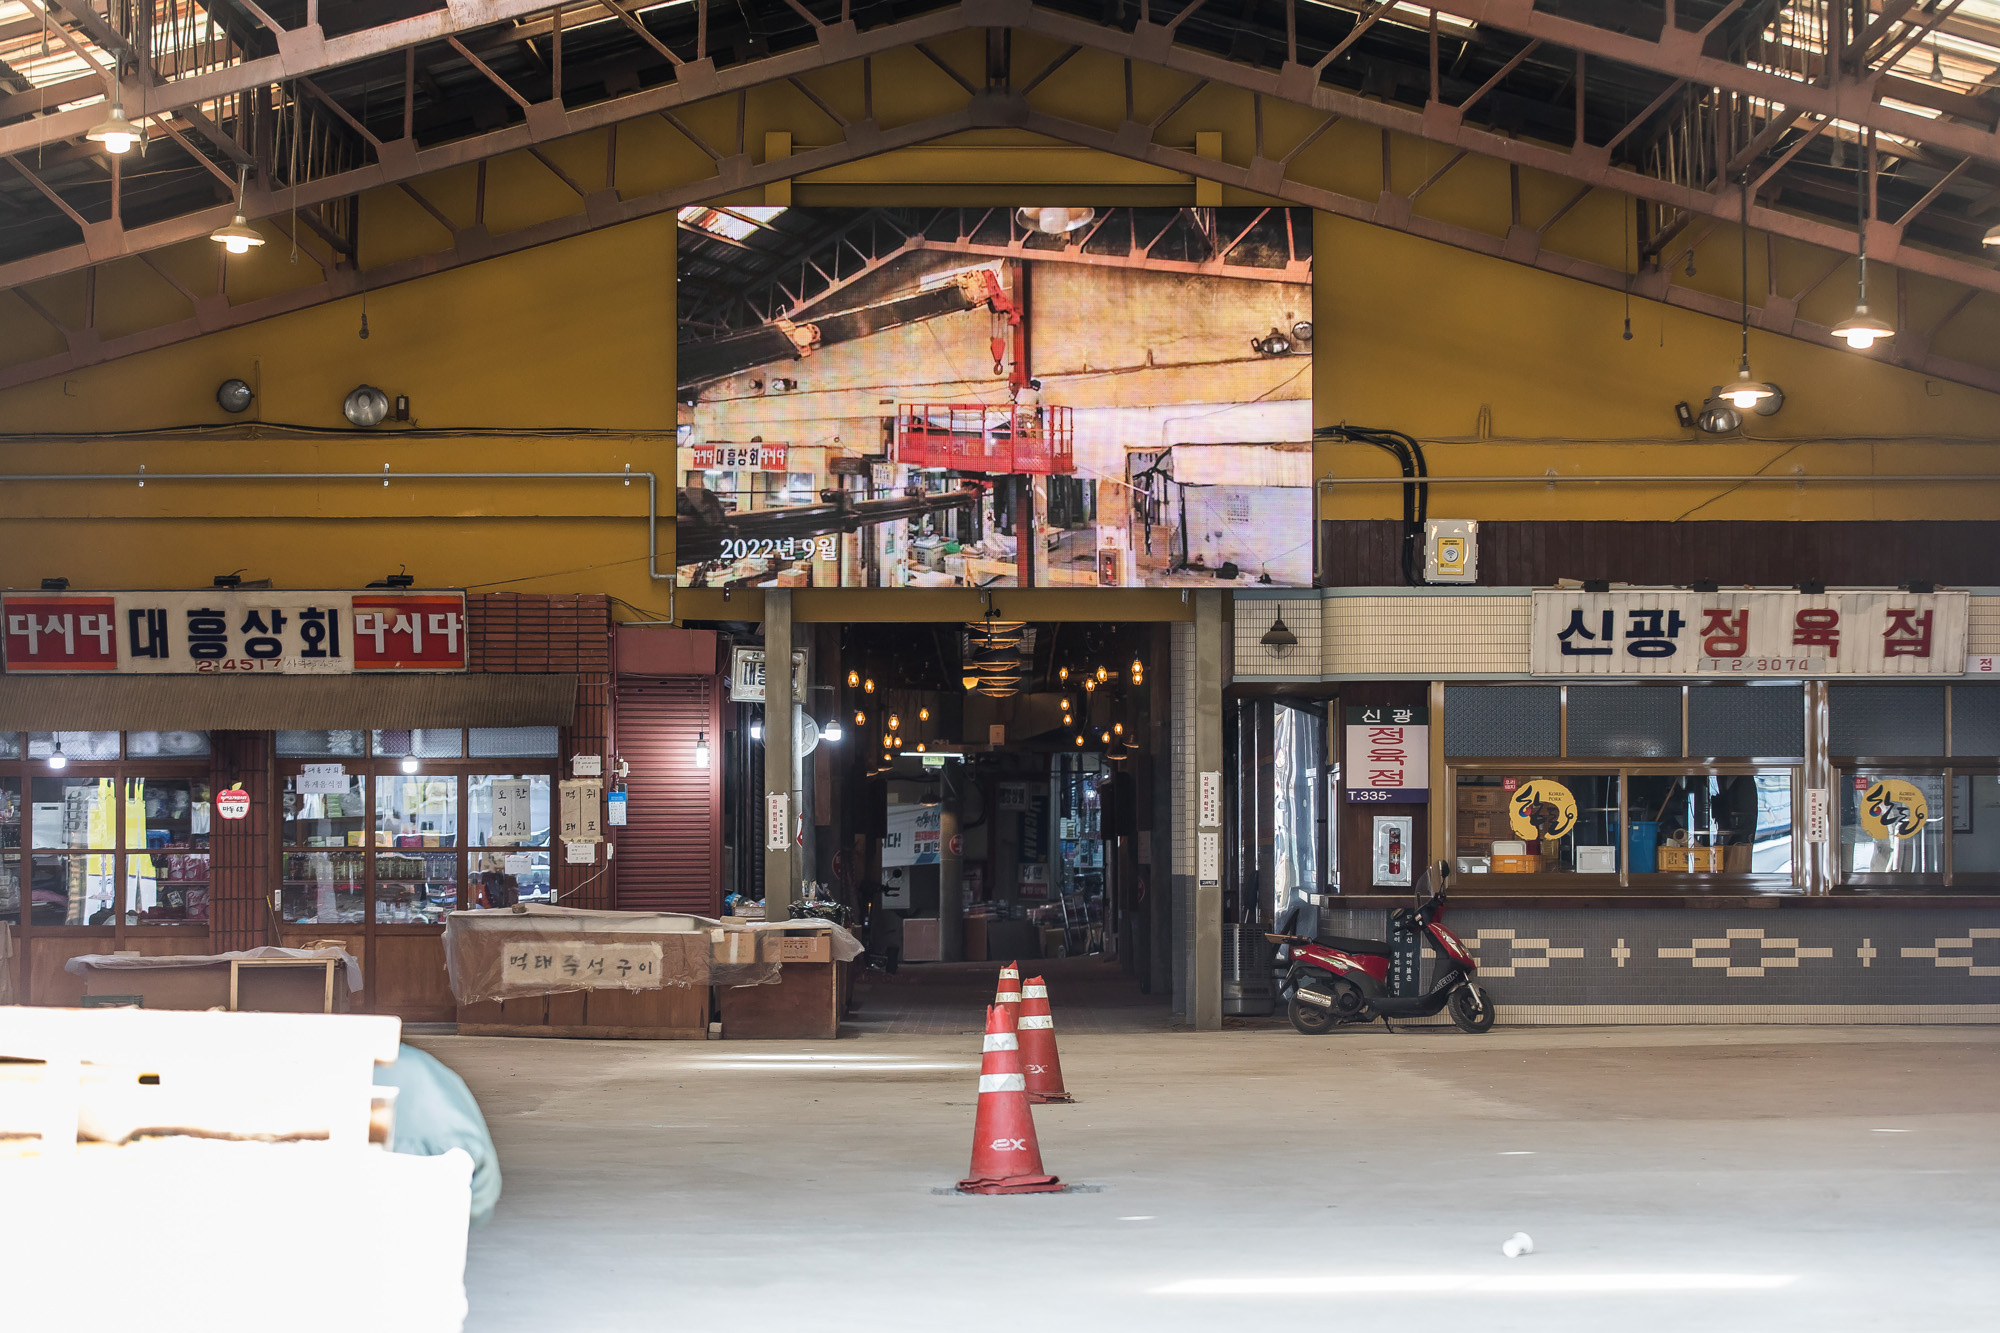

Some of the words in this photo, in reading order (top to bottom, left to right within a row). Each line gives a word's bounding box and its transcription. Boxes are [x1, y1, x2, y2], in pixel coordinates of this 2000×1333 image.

[716, 447, 759, 466] 대흥상회
[720, 537, 796, 561] 2022년
[802, 537, 837, 561] 9월
[8, 613, 113, 655] 다시다
[128, 607, 341, 658] 대흥상회
[355, 612, 462, 653] 다시다
[1557, 609, 1686, 658] 신광
[1700, 608, 1933, 658] 정육점
[1710, 659, 1719, 671] T
[1980, 658, 1992, 672] 정
[1362, 709, 1413, 723] 신광
[1367, 727, 1408, 787] 정육점
[497, 789, 508, 831] 오징어
[515, 788, 527, 830] 한치
[565, 790, 576, 831] 먹태
[586, 788, 596, 831] 쥐포
[1348, 791, 1392, 801] T.335-
[510, 953, 552, 971] 먹태
[562, 955, 605, 977] 즉석
[617, 958, 652, 977] 구이
[1393, 951, 1401, 996] 정리해드립니
